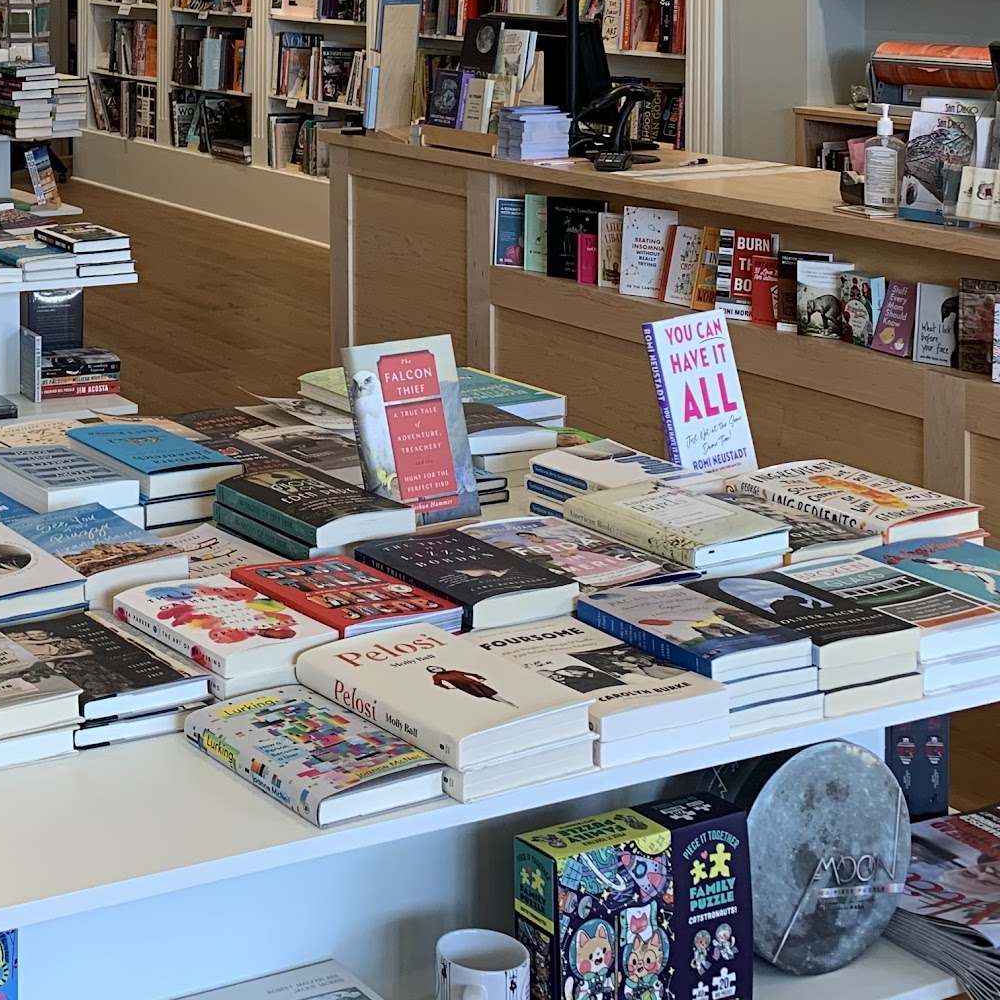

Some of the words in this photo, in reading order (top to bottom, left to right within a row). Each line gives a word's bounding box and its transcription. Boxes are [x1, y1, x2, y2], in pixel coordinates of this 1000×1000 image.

[606, 27, 616, 35] ART
[957, 103, 978, 114] DIEGO
[632, 243, 665, 251] INSOMNIA
[737, 237, 770, 252] BURN
[892, 285, 908, 295] Stuff
[887, 302, 904, 311] Mom
[890, 294, 908, 305] Every
[882, 318, 901, 327] Know
[885, 309, 907, 321] Should
[665, 324, 692, 345] YOU
[696, 318, 723, 339] CAN
[921, 333, 939, 343] before
[670, 347, 710, 374] HAVE
[713, 343, 726, 364] IT
[385, 367, 432, 383] FALCON
[76, 386, 88, 394] JIM
[90, 385, 109, 393] ACOSTA
[396, 384, 425, 396] THIEF
[684, 373, 738, 423] ALL
[401, 409, 418, 417] TRUE
[420, 406, 438, 414] TALE
[397, 430, 442, 442] ADVENTURE,
[401, 442, 442, 454] TREACHERY
[693, 459, 711, 470] ROMI
[713, 448, 747, 464] NEUSTADT
[404, 474, 422, 482] HUNT
[749, 461, 844, 483] INGREDIENTS
[407, 483, 433, 493] PERFECT
[435, 480, 449, 488] BIRD
[383, 543, 412, 553] THE
[419, 538, 460, 547] TRIAL
[415, 552, 495, 568] BORDEN
[793, 562, 869, 581] BROKEN
[823, 571, 885, 588] GLASS
[479, 627, 584, 650] FOURSOME
[334, 634, 447, 667] Pelosi
[390, 658, 416, 669] Molly
[418, 654, 435, 663] Ball
[598, 686, 652, 703] CAROLYN
[654, 680, 692, 694] BURKE
[334, 679, 378, 721] Pelosi
[385, 713, 403, 732] Molly
[404, 725, 418, 737] Ball
[689, 877, 736, 899] FAMILY
[690, 891, 735, 912] PUZZLE
[688, 906, 738, 925] CATSTRONAUTS!
[719, 978, 730, 990] 20
